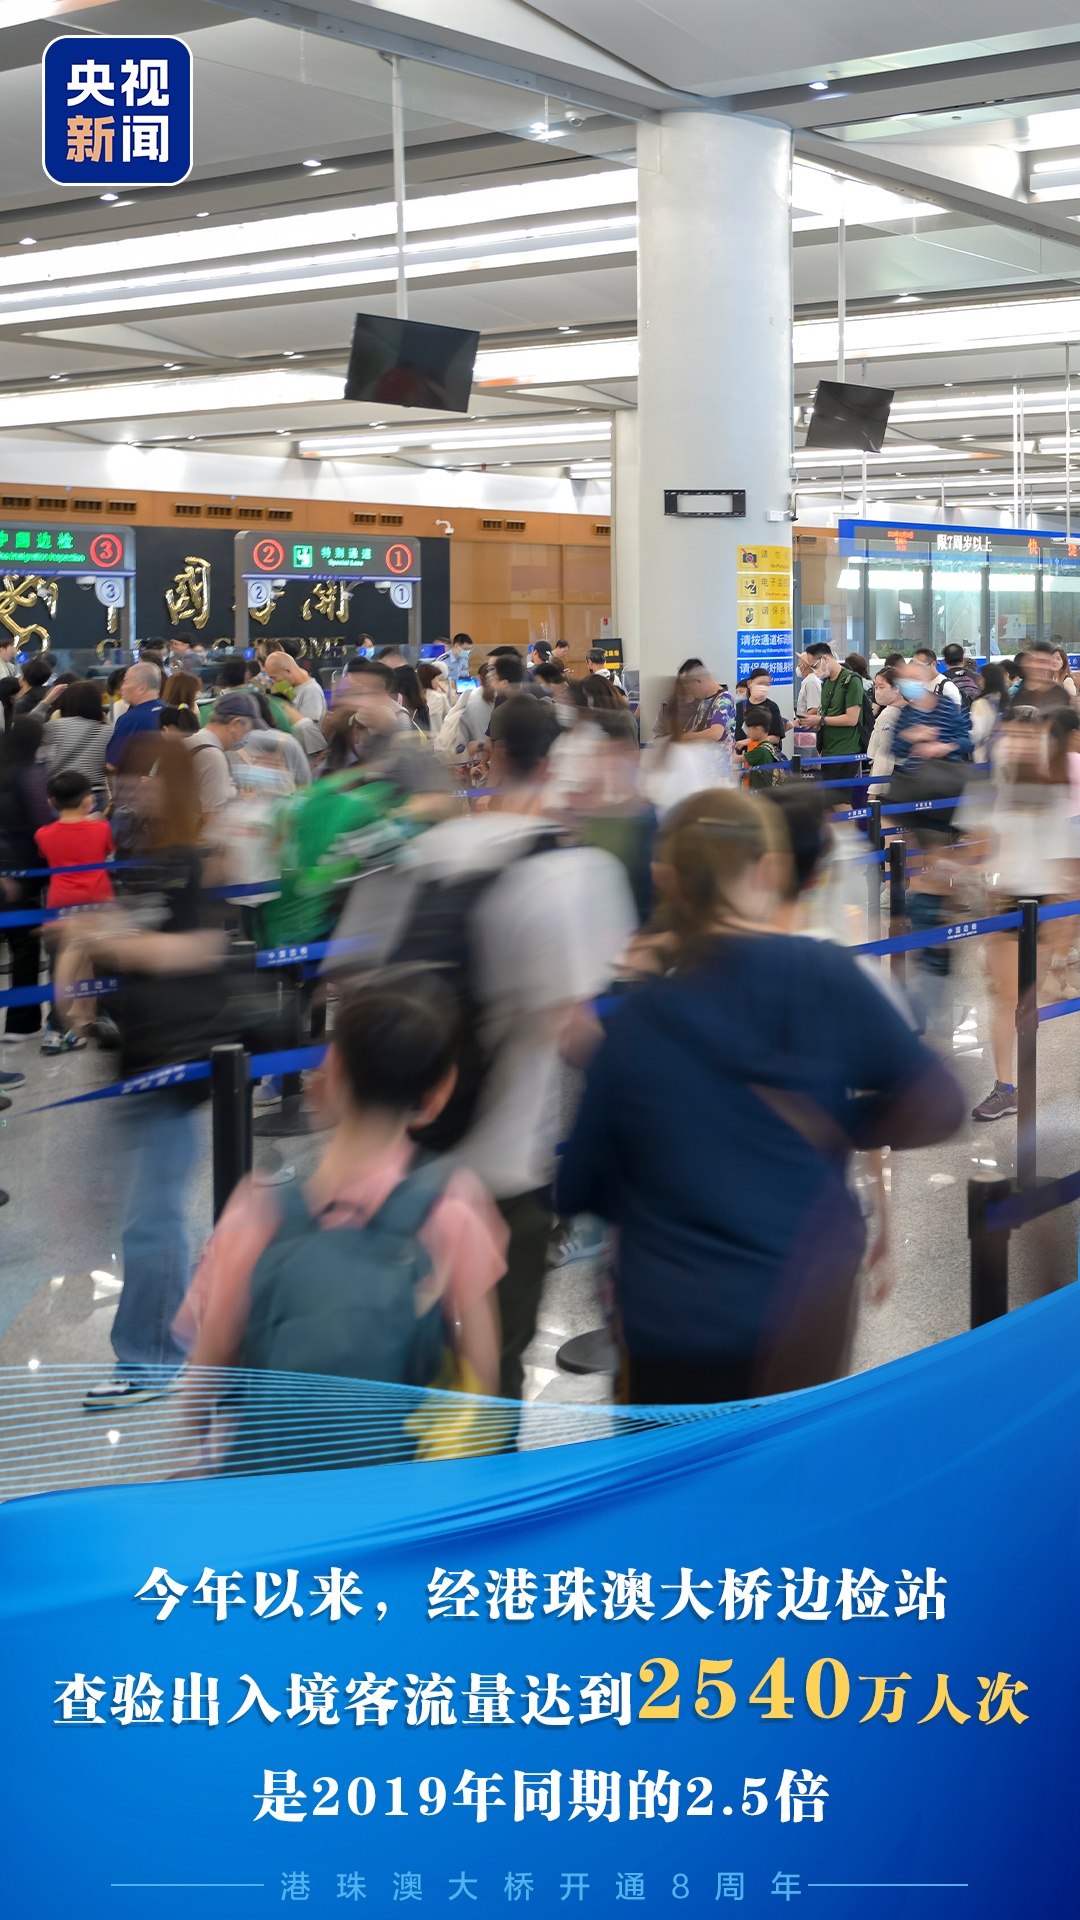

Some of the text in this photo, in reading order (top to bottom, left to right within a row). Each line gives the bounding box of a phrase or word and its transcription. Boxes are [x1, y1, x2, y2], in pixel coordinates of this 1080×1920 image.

[937, 534, 992, 552] 限7周岁以上
